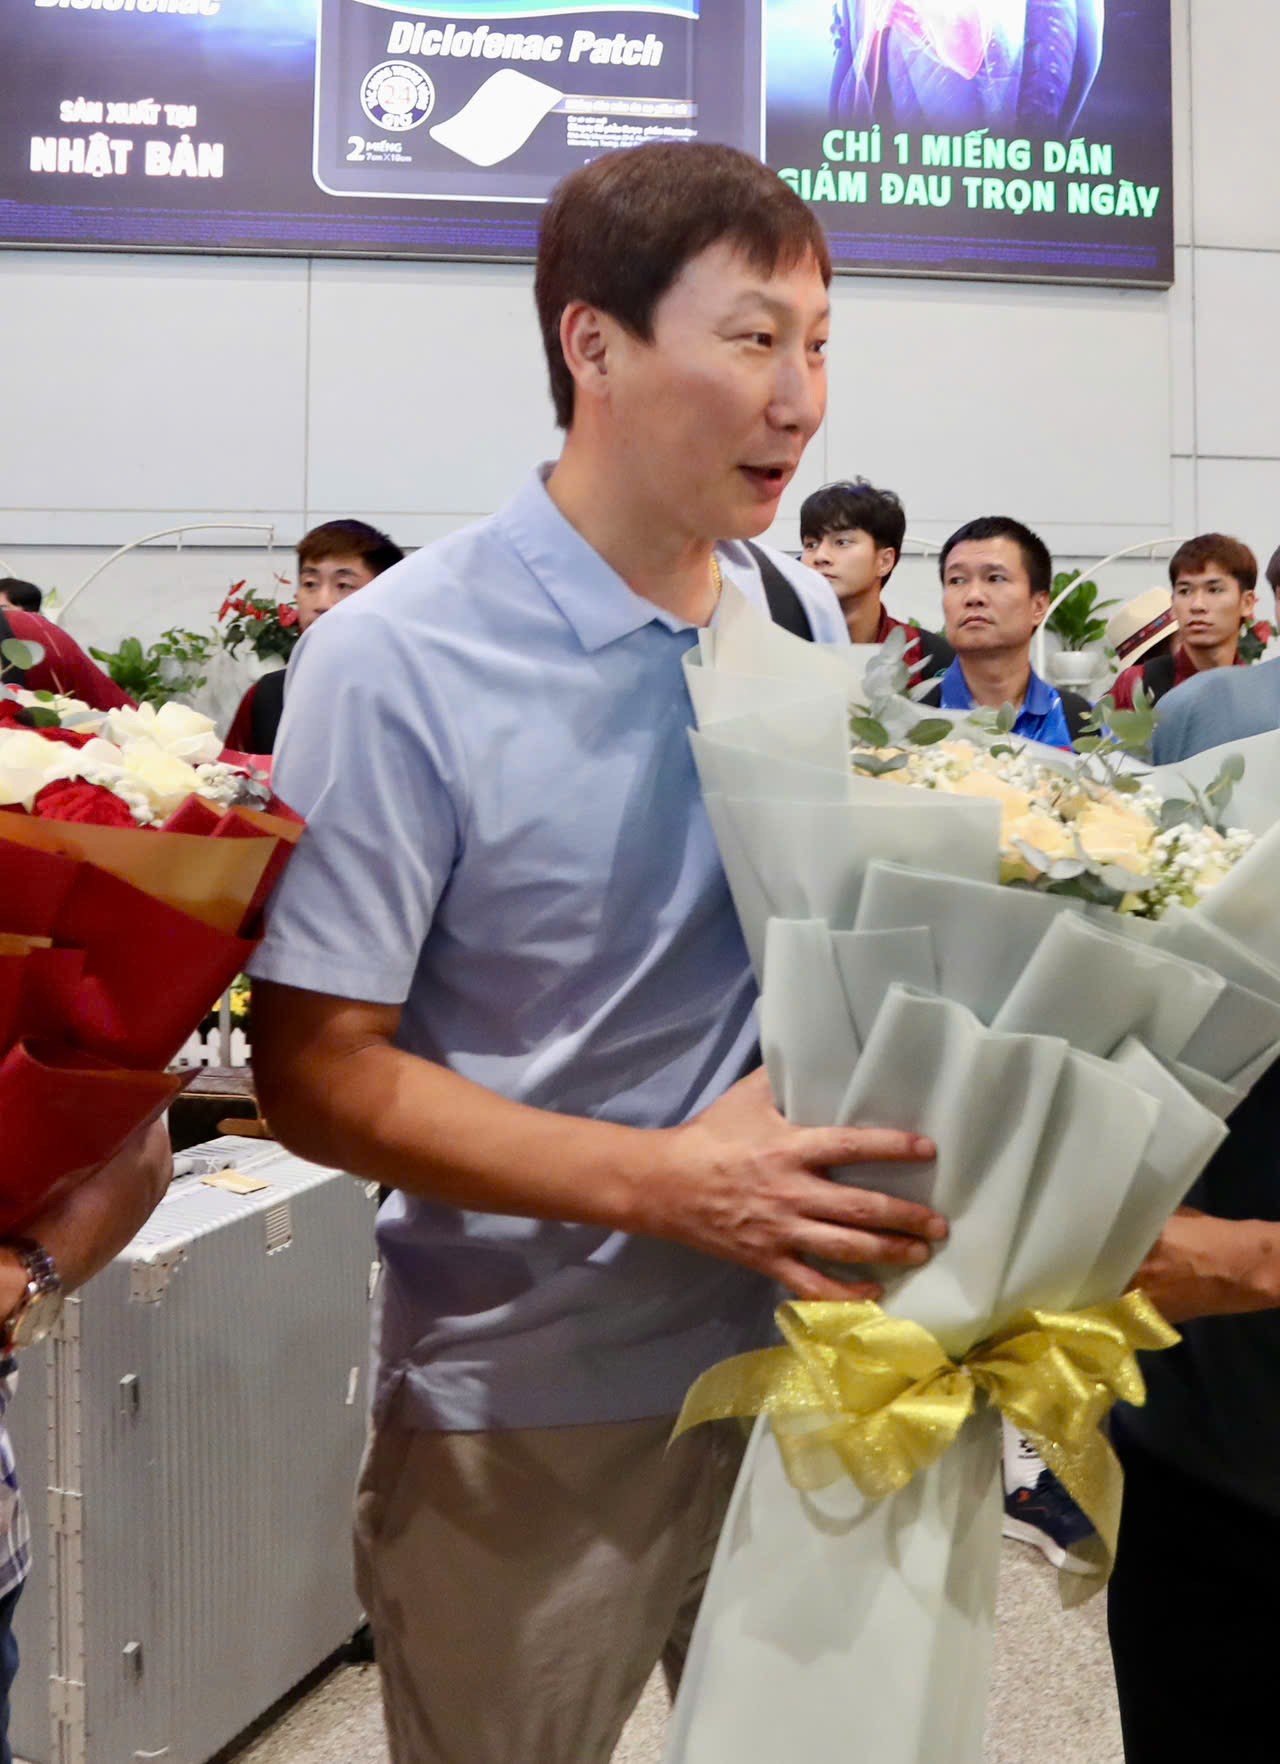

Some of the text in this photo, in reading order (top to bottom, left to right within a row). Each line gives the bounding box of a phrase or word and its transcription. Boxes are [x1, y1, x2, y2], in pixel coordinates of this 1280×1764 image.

[387, 21, 664, 66] Diclofenac Patch
[60, 96, 103, 123] SẢN
[105, 98, 161, 125] XUẤT
[30, 131, 224, 178] NHẬT BẢN
[346, 136, 365, 161] 2
[822, 124, 1113, 175] CHỈ 1 MIẾNG DÁN
[880, 172, 952, 207] ĐAU
[962, 176, 1055, 215] TRỌN
[1067, 179, 1160, 218] NGÀY
